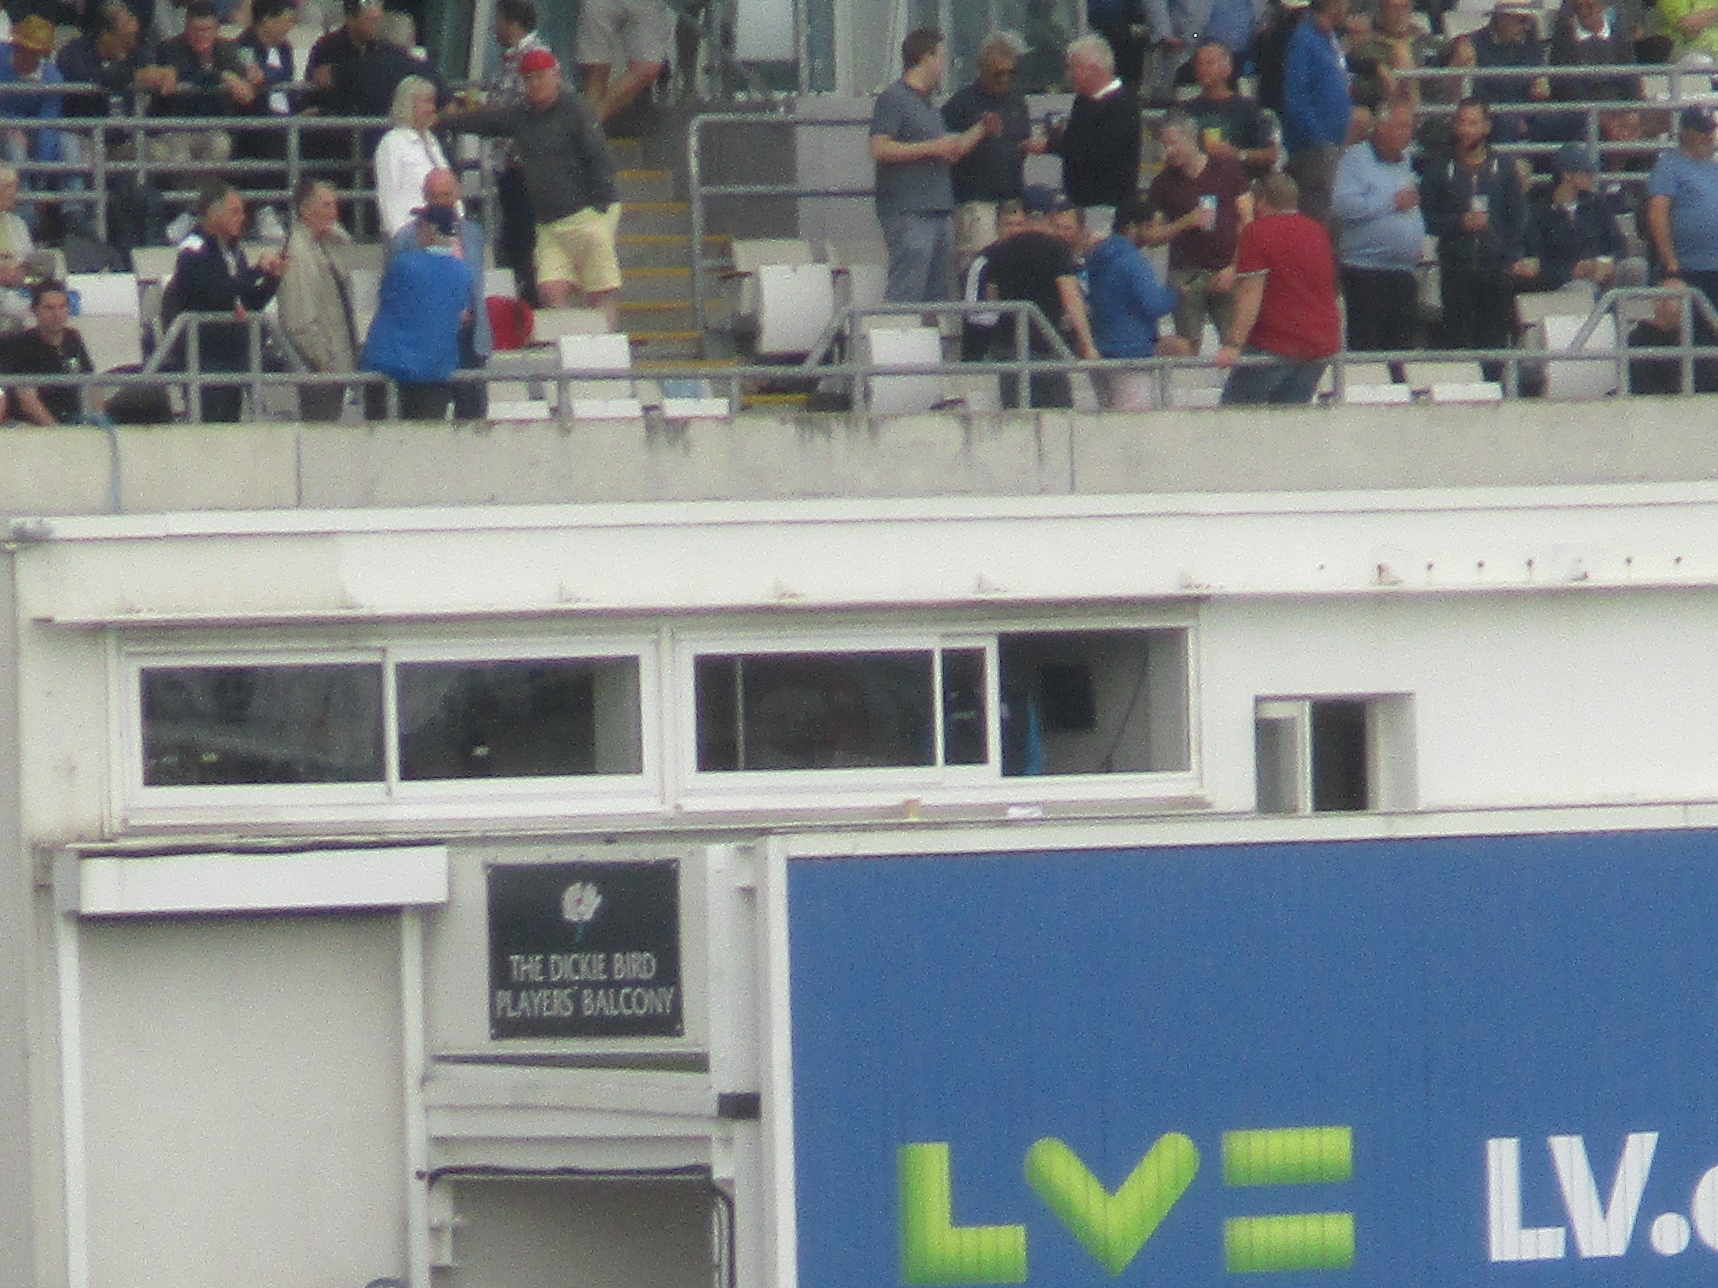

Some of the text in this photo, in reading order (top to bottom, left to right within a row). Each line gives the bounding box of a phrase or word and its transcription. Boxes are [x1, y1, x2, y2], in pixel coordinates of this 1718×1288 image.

[508, 951, 658, 981] THE DICKIE BIRD
[582, 985, 675, 1016] BALCONY
